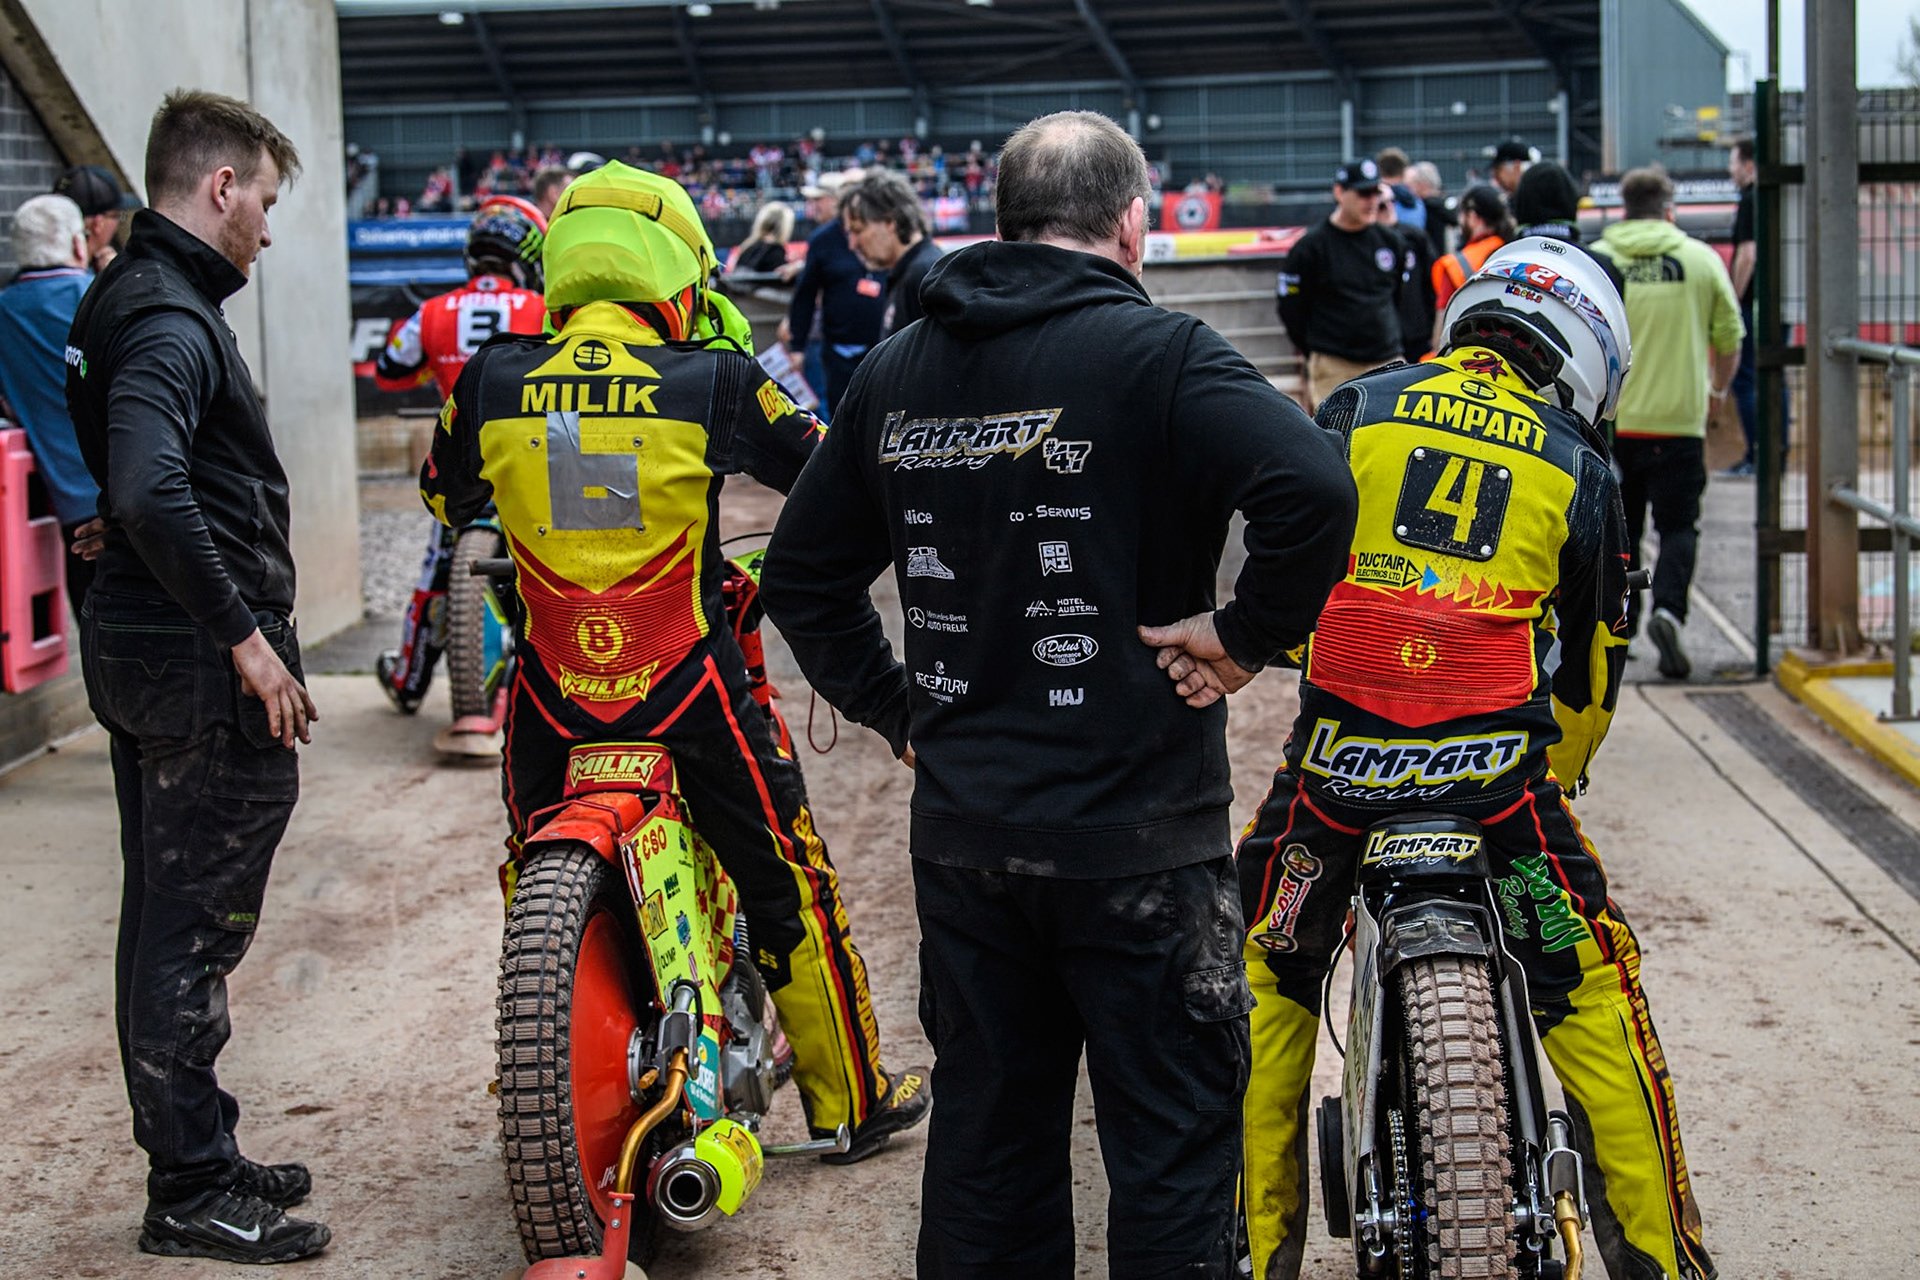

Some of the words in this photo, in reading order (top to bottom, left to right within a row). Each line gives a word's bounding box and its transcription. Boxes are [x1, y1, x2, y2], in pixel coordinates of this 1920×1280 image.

[1543, 242, 1565, 255] SHOEI
[521, 376, 661, 415] MILÍK
[1393, 394, 1548, 453] LAMPART
[881, 411, 1057, 460] LAMPART
[1043, 438, 1092, 474] #47
[894, 453, 995, 473] Racing
[1424, 455, 1485, 544] 4
[1358, 552, 1406, 572] DUCTAIR
[1356, 568, 1388, 580] ELECTRICS
[1056, 598, 1085, 606] HOTEL
[1058, 605, 1099, 613] AUSTERIA
[942, 623, 969, 633] FRELIK
[1049, 687, 1085, 707] HAJ
[1306, 723, 1525, 783] LAMPART
[571, 755, 656, 779] MILIK
[1322, 779, 1454, 800] Racing
[1366, 833, 1480, 861] LAMPART
[1376, 855, 1443, 869] Racing
